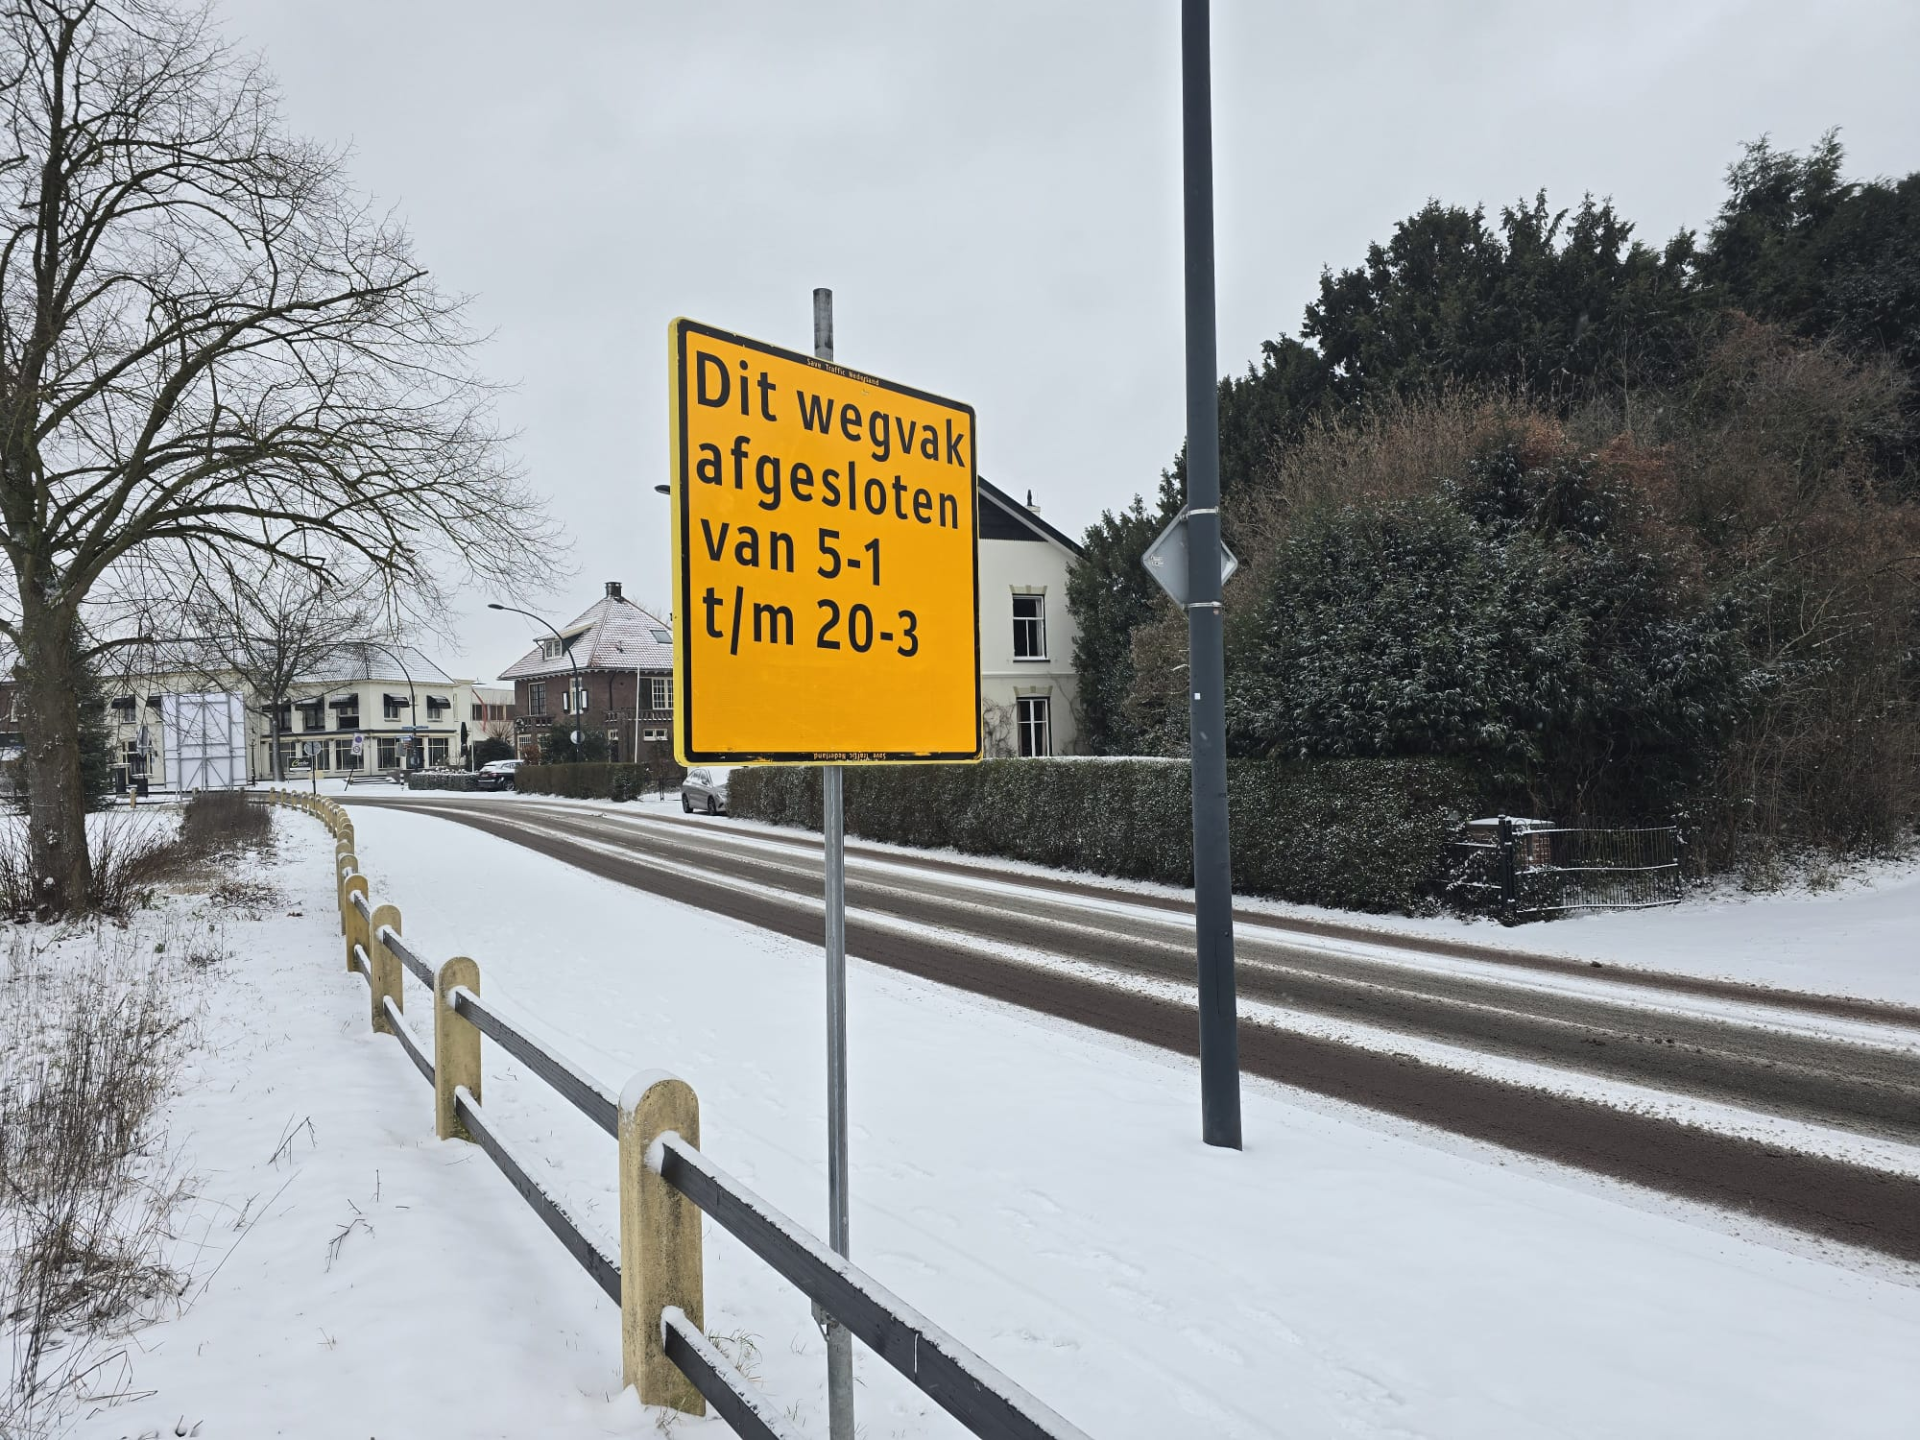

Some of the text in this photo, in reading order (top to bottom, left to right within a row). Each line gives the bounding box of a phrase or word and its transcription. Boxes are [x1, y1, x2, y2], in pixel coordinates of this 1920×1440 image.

[697, 351, 965, 467] Dit wegvak
[825, 364, 845, 375] Traffic
[848, 372, 879, 385] Nederland
[697, 436, 958, 529] afgesloten
[701, 519, 879, 586] van 5-1
[703, 586, 918, 657] t/m 20-3
